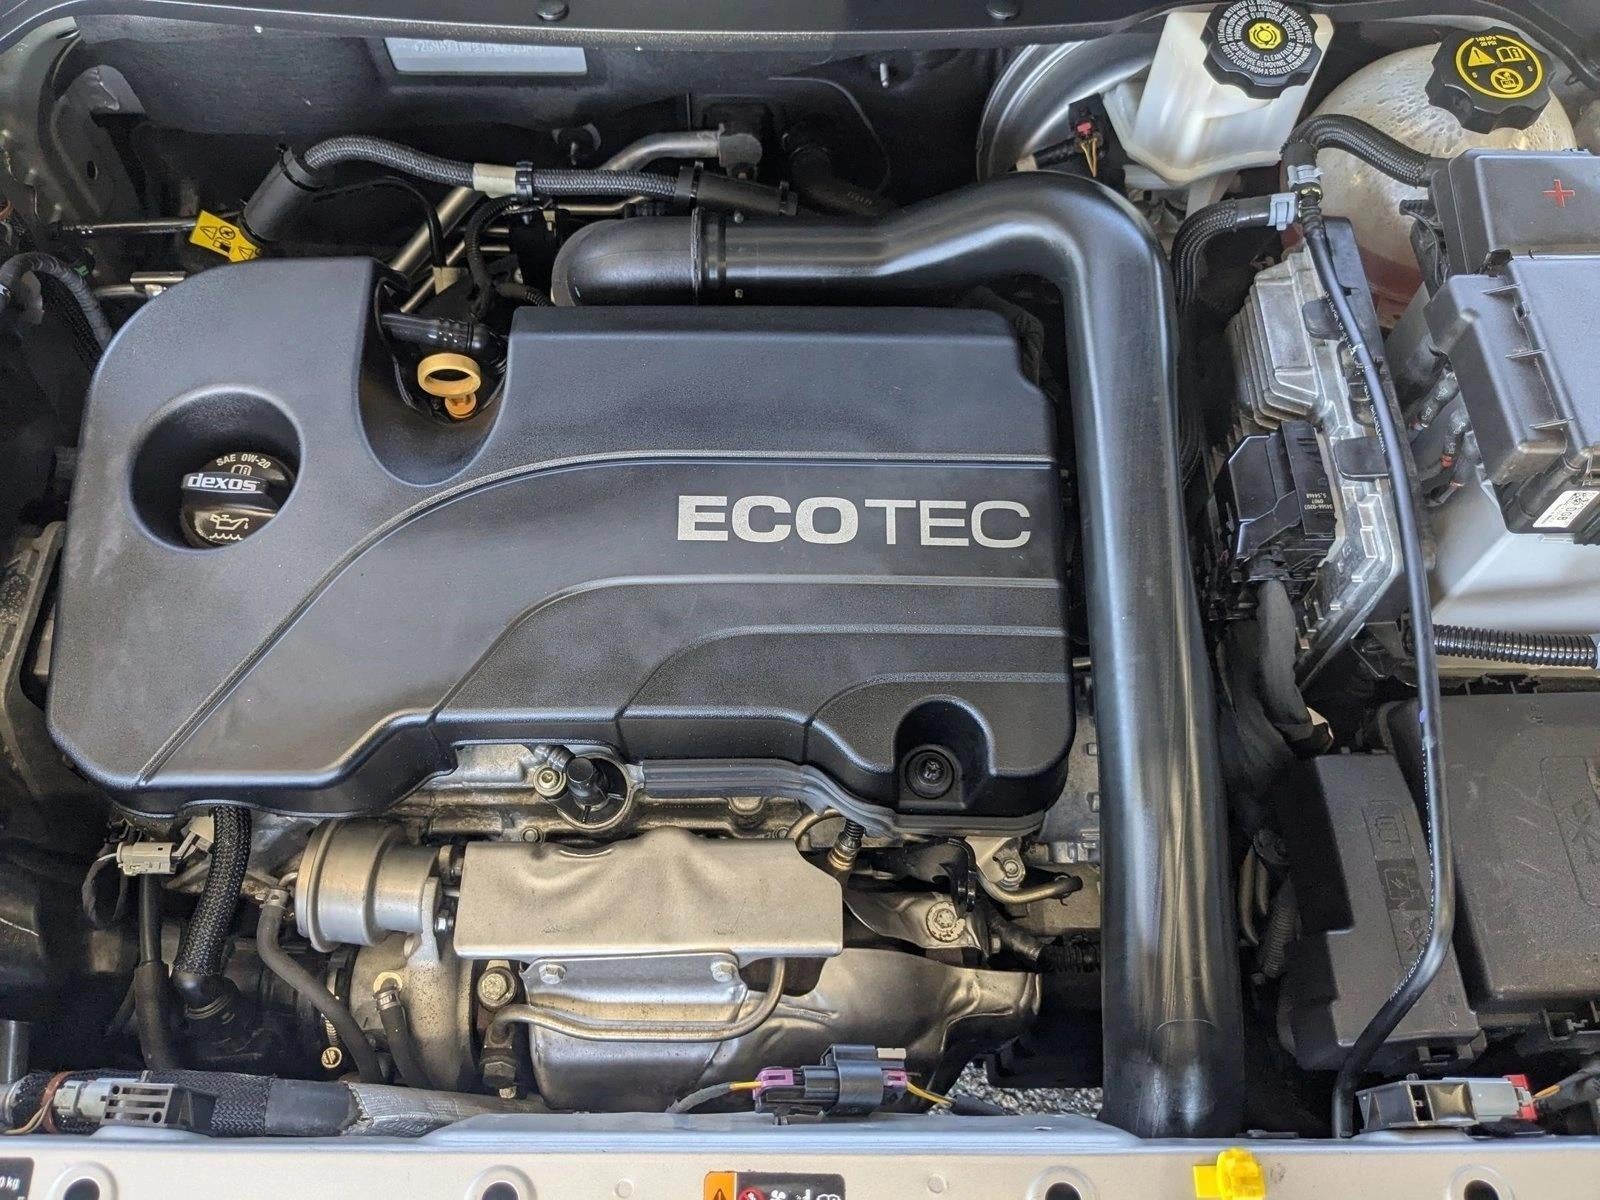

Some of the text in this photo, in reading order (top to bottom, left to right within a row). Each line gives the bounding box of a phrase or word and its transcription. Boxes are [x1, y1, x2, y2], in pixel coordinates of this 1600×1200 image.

[1229, 42, 1239, 51] CAP
[1235, 50, 1257, 65] BEFORE
[1263, 53, 1282, 61] CLEAN
[1280, 41, 1295, 57] FILLER
[1230, 55, 1247, 68] FLUID
[1246, 64, 1264, 74] FROM
[1269, 65, 1291, 76] SEALED
[216, 453, 271, 469] SAE 0W-20
[187, 473, 260, 492] dexos
[677, 495, 1031, 548] ECOTEC
